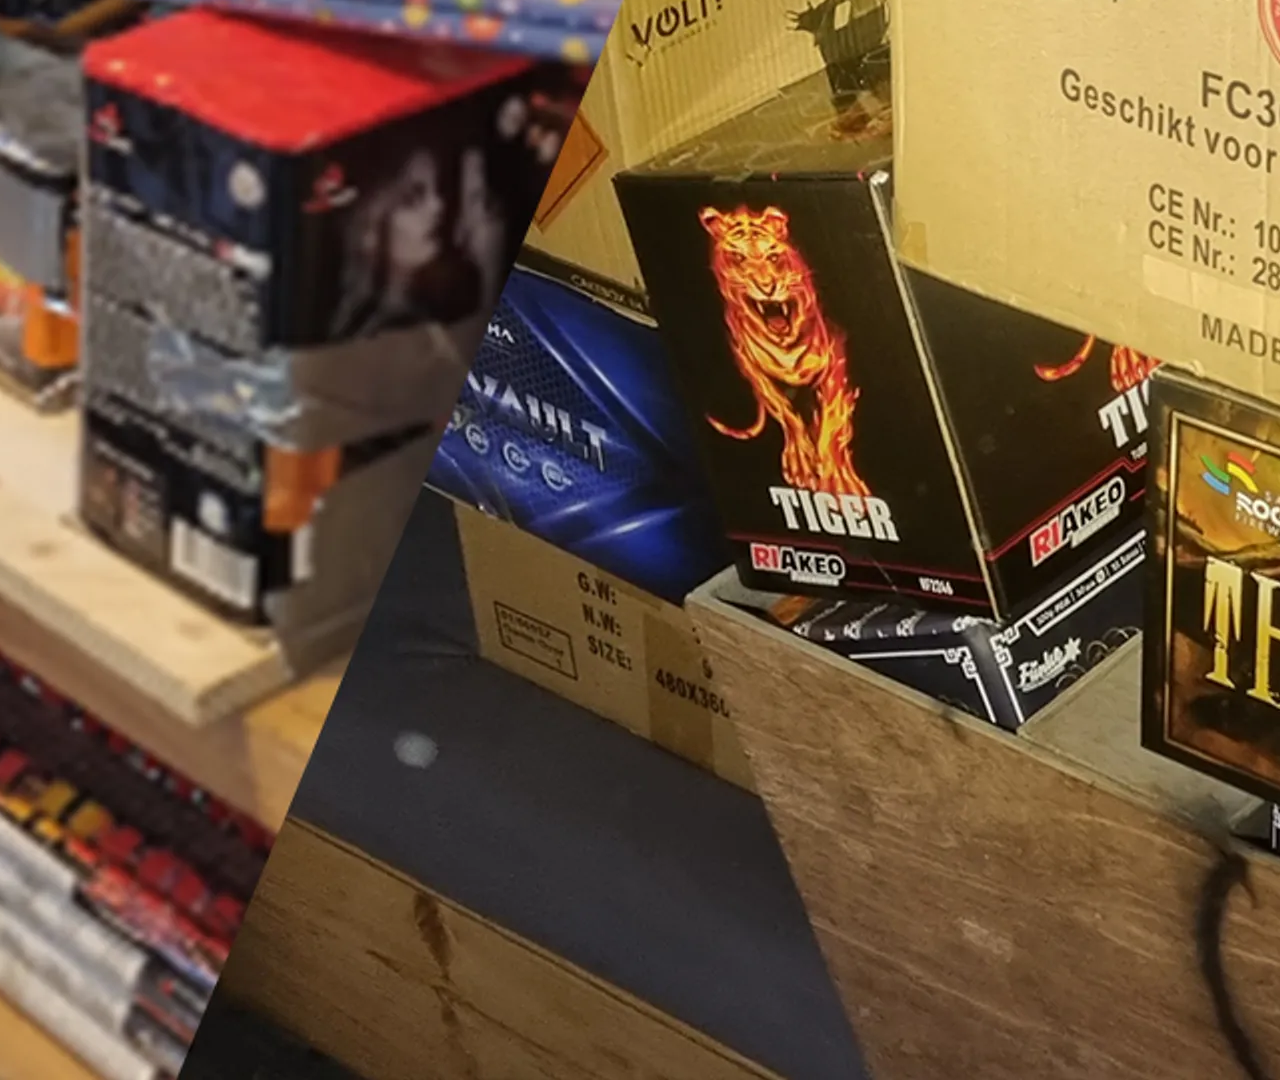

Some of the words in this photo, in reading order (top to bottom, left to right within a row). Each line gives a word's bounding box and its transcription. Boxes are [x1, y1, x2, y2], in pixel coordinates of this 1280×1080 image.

[1059, 68, 1197, 149] Geschikt
[1203, 126, 1278, 174] voor
[1148, 184, 1184, 218] CE
[1192, 198, 1237, 239] Nr.:
[1148, 220, 1184, 254] CE
[1192, 235, 1237, 276] Nr.:
[769, 486, 900, 542] TIGER
[1030, 476, 1126, 567] RIAKEO
[577, 571, 618, 606] G.W:
[750, 542, 846, 580] RIAKEO
[582, 603, 622, 637] N.W:
[587, 635, 633, 671] SIZE:
